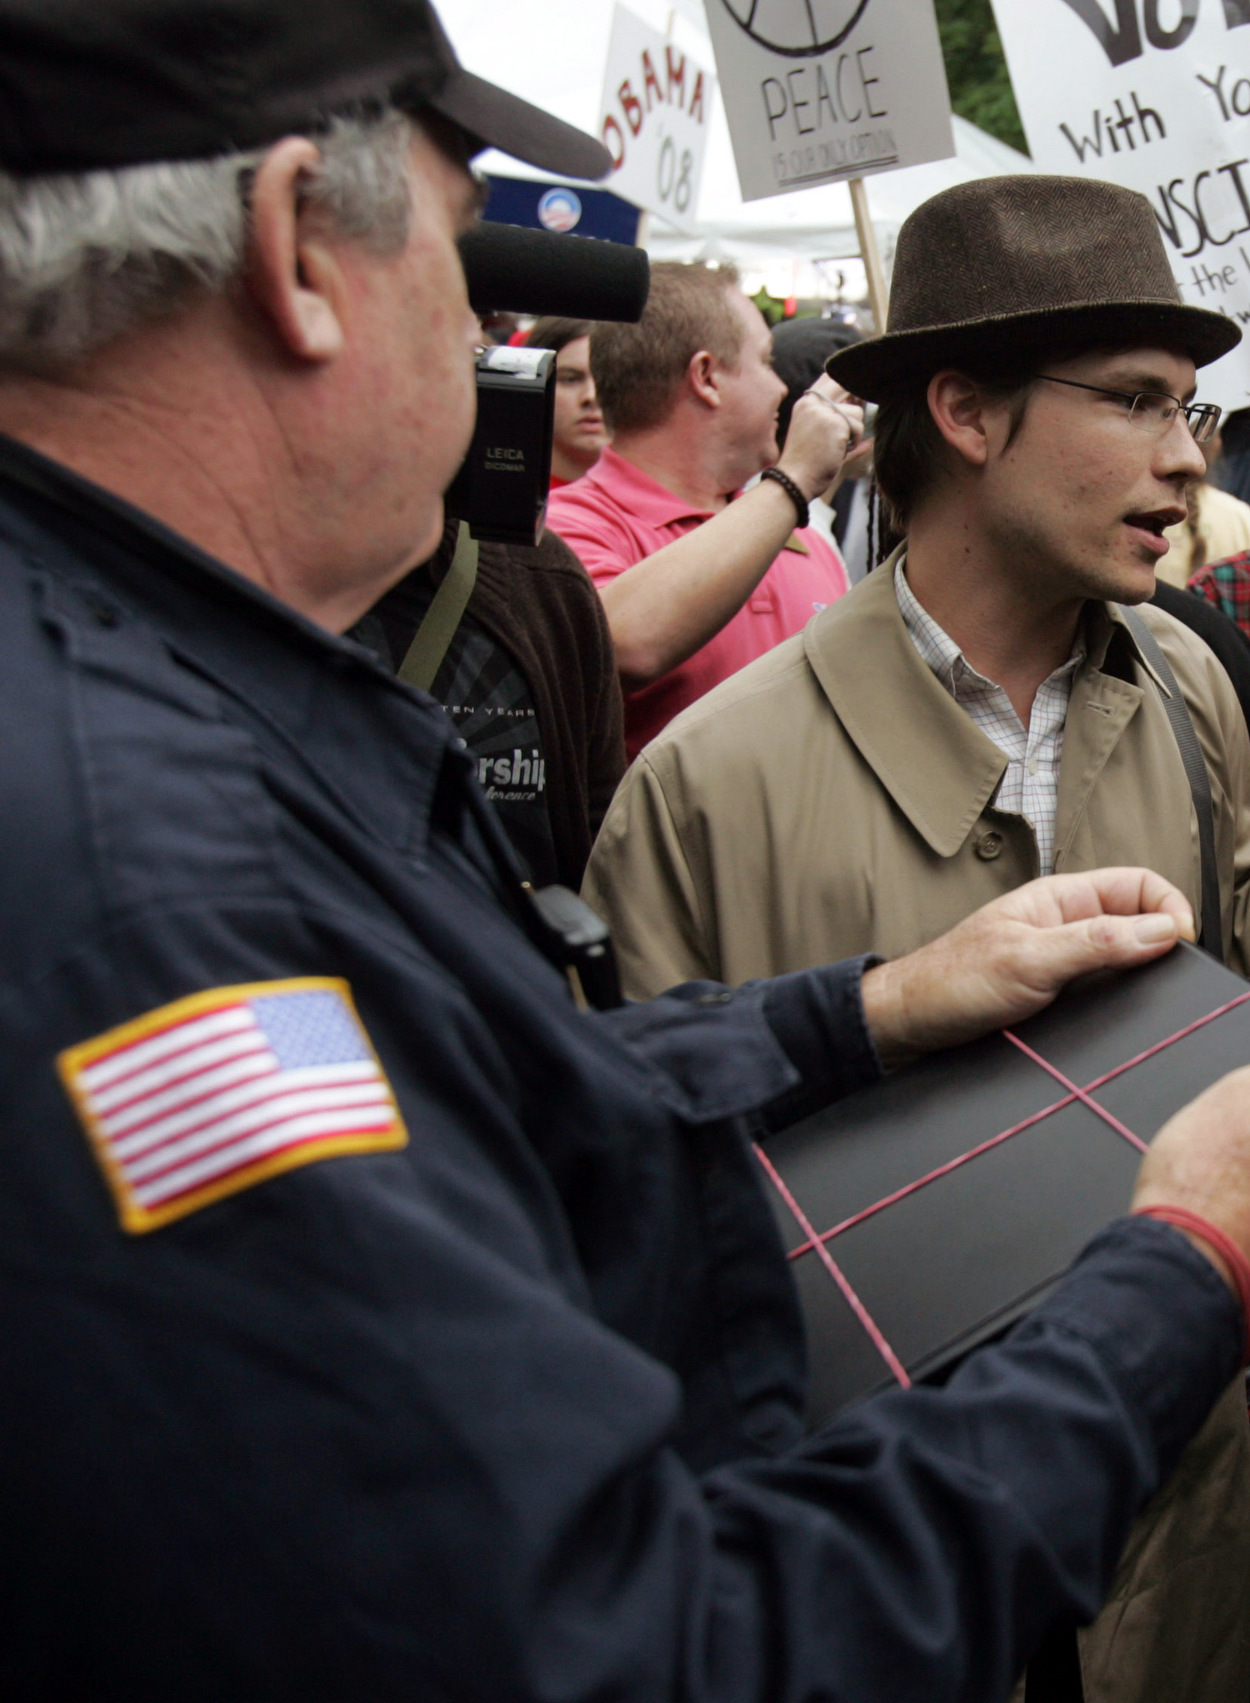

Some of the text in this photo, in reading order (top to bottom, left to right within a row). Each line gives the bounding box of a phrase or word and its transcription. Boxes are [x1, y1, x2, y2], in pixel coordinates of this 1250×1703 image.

[602, 45, 704, 171] OBAMA
[761, 46, 887, 141] PEACE
[1059, 91, 1167, 163] With
[1191, 263, 1238, 297] the
[486, 447, 525, 461] LEICA
[440, 704, 536, 718] TEN YEARS
